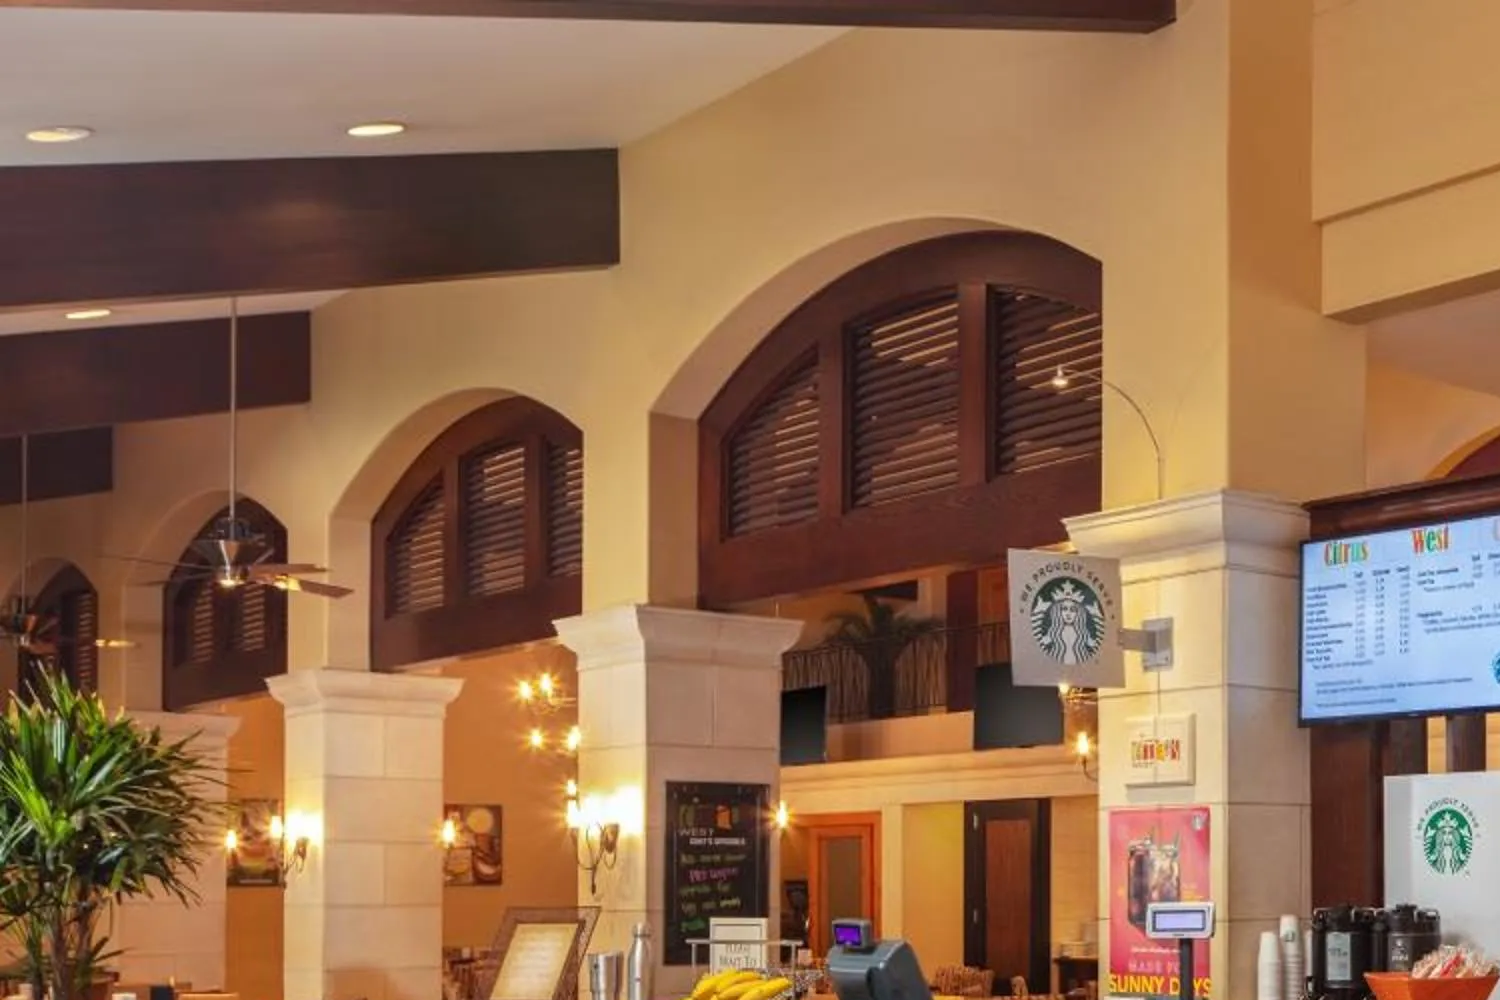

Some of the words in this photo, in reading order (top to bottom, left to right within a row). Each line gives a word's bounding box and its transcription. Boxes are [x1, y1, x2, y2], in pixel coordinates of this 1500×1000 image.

[1324, 540, 1369, 567] Citrus
[1412, 527, 1450, 554] West
[1032, 561, 1085, 583] PROUDLY
[1108, 973, 1166, 994] SUNNY
[1169, 975, 1213, 996] DYS
